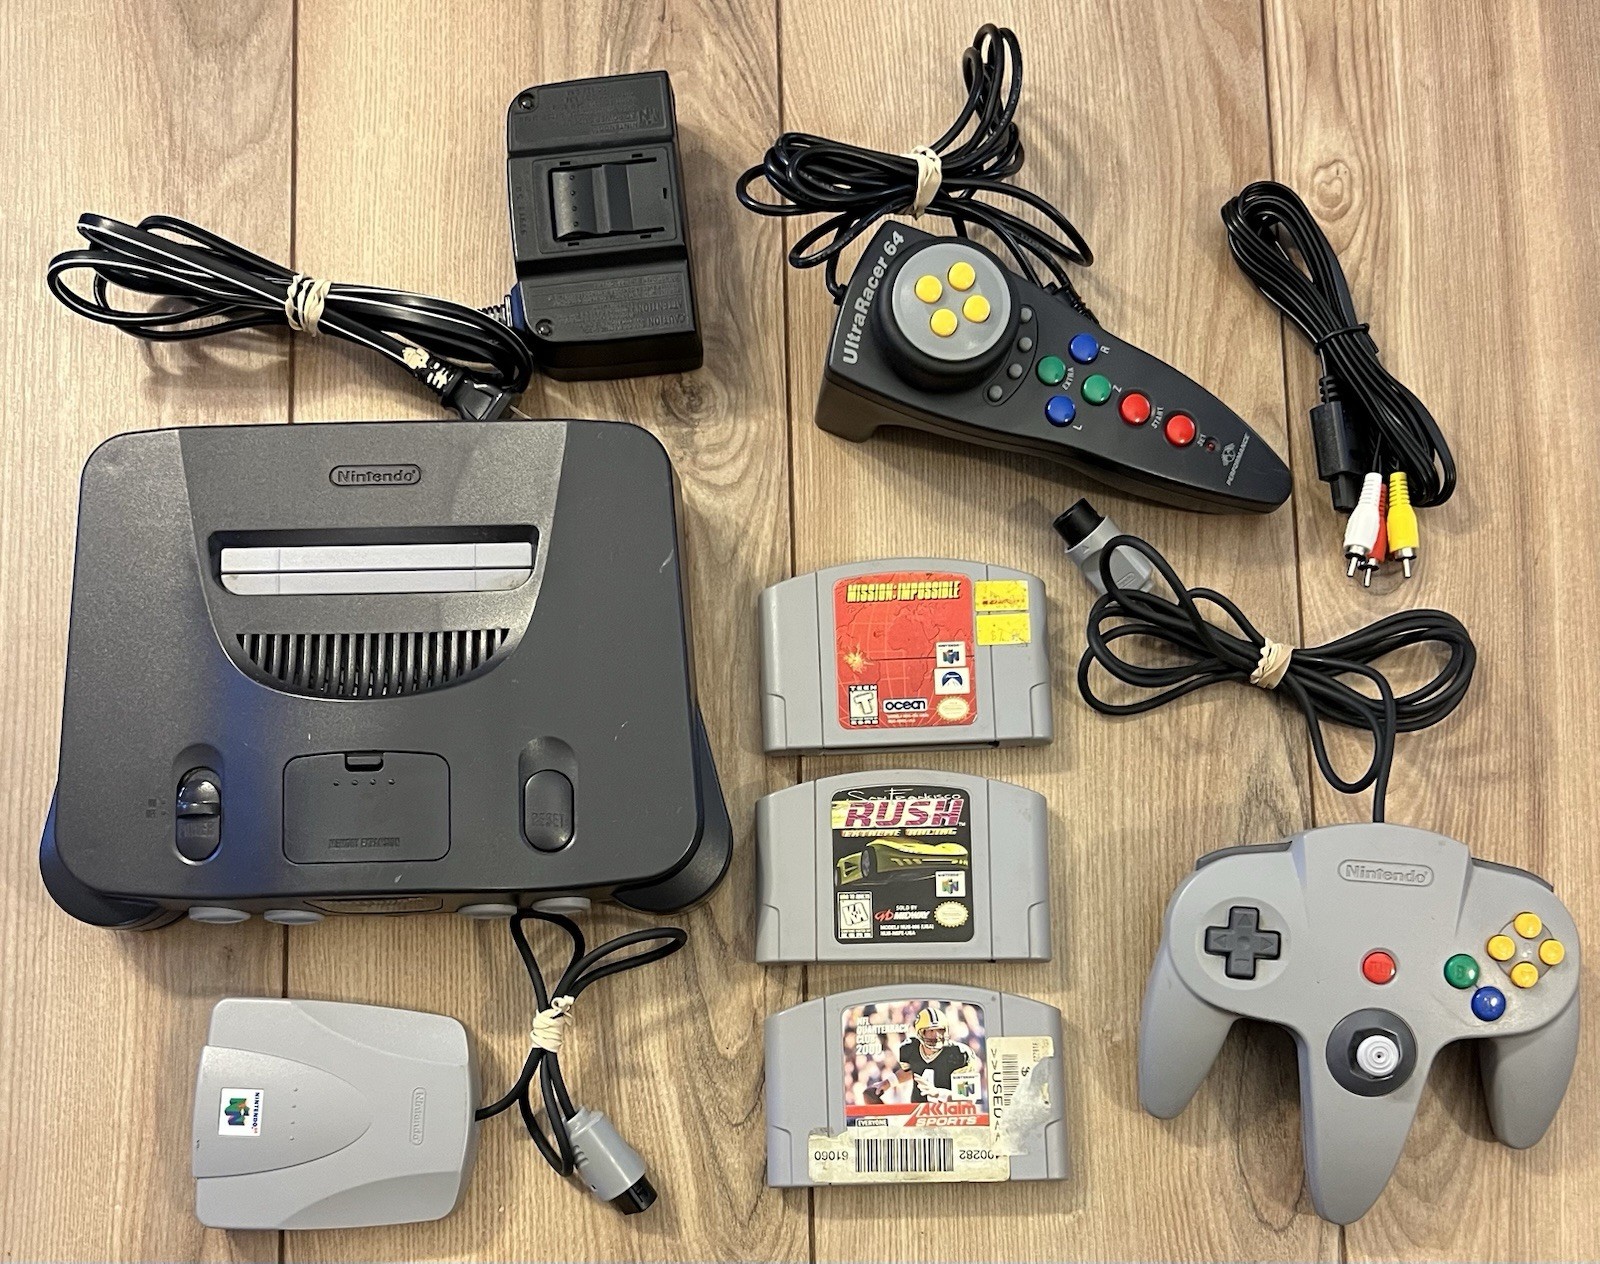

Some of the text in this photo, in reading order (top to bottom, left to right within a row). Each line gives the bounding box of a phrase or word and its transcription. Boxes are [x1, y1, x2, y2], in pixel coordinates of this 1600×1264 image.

[842, 230, 905, 365] UltraRacer 64
[649, 313, 687, 328] CAUTION
[1099, 345, 1111, 355] R
[1061, 366, 1075, 391] EXTRA
[1112, 384, 1123, 393] Z
[1150, 406, 1165, 429] START
[337, 469, 415, 483] Nintendo
[885, 700, 926, 711] ocean
[844, 798, 964, 828] RUSH
[530, 812, 565, 828] RESET
[1345, 863, 1428, 884] Nintendo
[894, 911, 931, 920] MIDWAY
[856, 1016, 870, 1026] NFL
[856, 1023, 910, 1034] QUARTERBACK
[856, 1034, 878, 1044] CLUB
[855, 1043, 883, 1055] 2000
[252, 1091, 261, 1127] NINTENDO
[412, 1091, 424, 1142] Nintendo
[915, 1116, 977, 1127] SPORTS
[813, 1149, 999, 1161] 61060 00282
